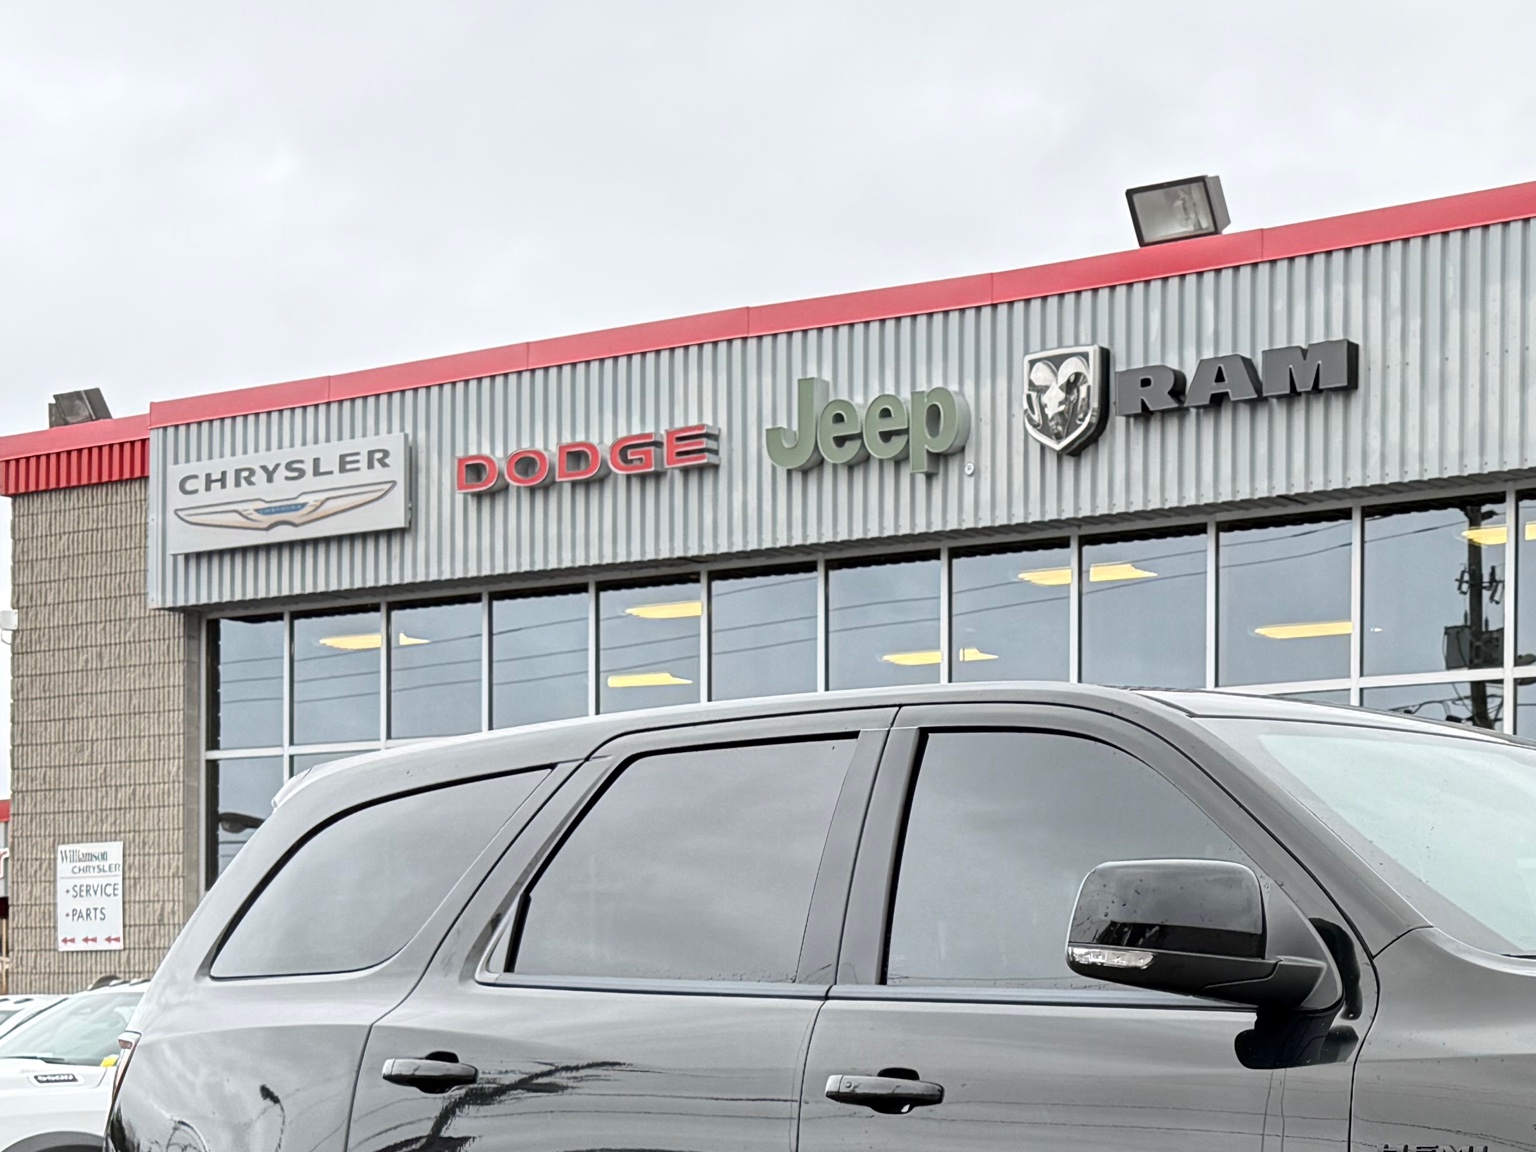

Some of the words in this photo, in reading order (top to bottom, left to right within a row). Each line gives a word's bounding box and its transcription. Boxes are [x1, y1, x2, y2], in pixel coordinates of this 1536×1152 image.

[1114, 338, 1354, 417] RAM
[765, 376, 968, 475] Jeep
[178, 448, 391, 496] CHRYSLER
[456, 423, 718, 495] DODGE
[60, 849, 108, 864] Williamson
[71, 863, 121, 875] CHRYSLER
[72, 883, 119, 898] SERVICE
[72, 906, 107, 921] PARTS
